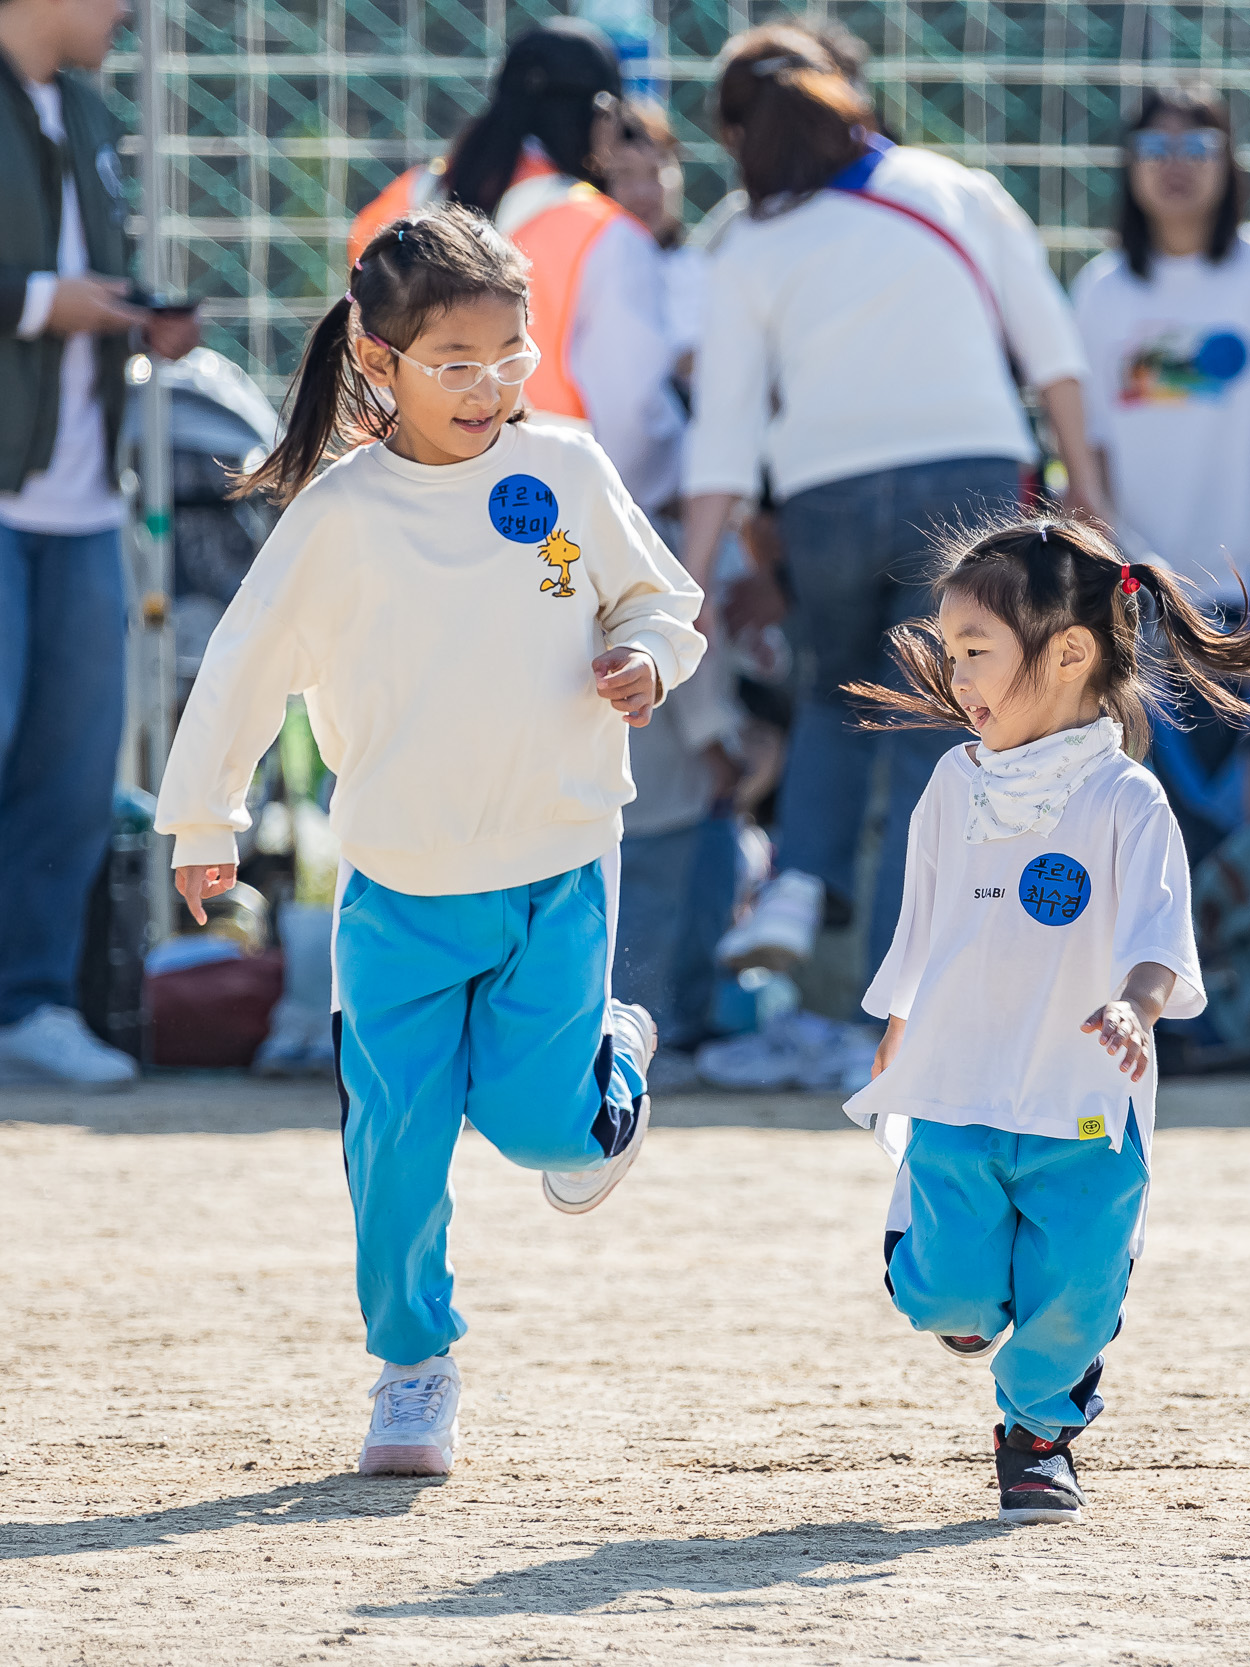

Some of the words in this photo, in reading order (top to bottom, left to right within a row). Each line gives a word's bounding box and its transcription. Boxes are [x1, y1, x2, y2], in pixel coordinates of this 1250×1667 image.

[491, 484, 553, 508] 푸르내
[498, 515, 548, 535] 강보미
[1028, 858, 1087, 892] 푸르내
[1023, 885, 1082, 918] 최수겸
